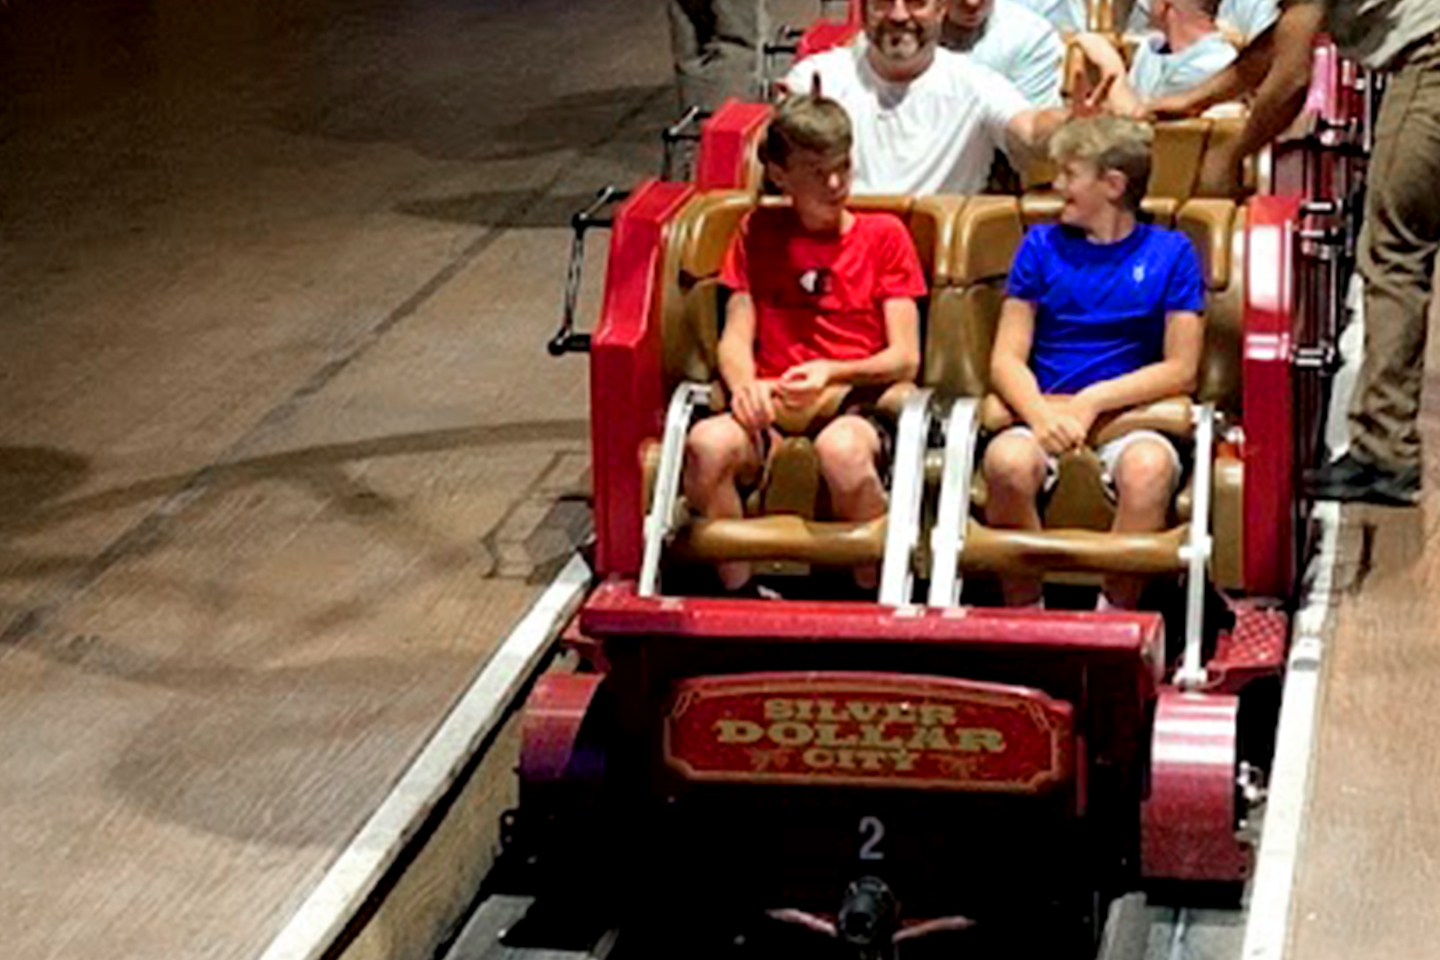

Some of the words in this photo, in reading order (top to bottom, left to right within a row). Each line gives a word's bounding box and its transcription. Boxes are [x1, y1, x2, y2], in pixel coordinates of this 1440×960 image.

[763, 698, 957, 725] SILVER
[711, 719, 1007, 753] DOLLAR
[802, 747, 920, 771] CITY
[859, 816, 885, 860] 2
